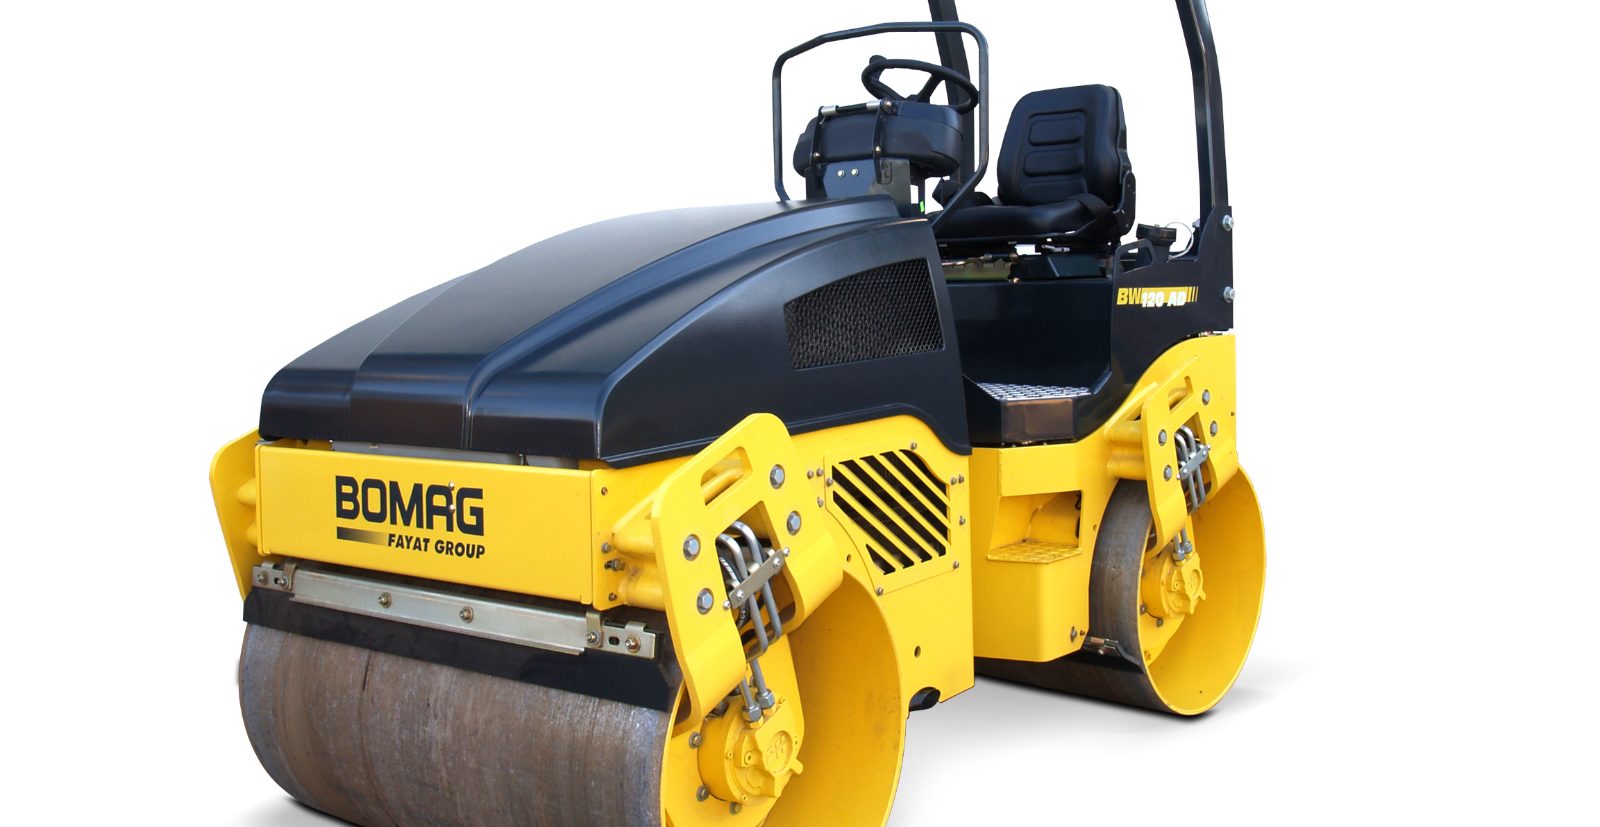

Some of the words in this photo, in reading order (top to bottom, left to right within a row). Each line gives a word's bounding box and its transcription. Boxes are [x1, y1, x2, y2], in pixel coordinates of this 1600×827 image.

[1167, 291, 1188, 307] AD
[335, 475, 485, 536] BOMAG
[388, 533, 430, 552] FAYAT
[435, 540, 486, 559] GROUP
